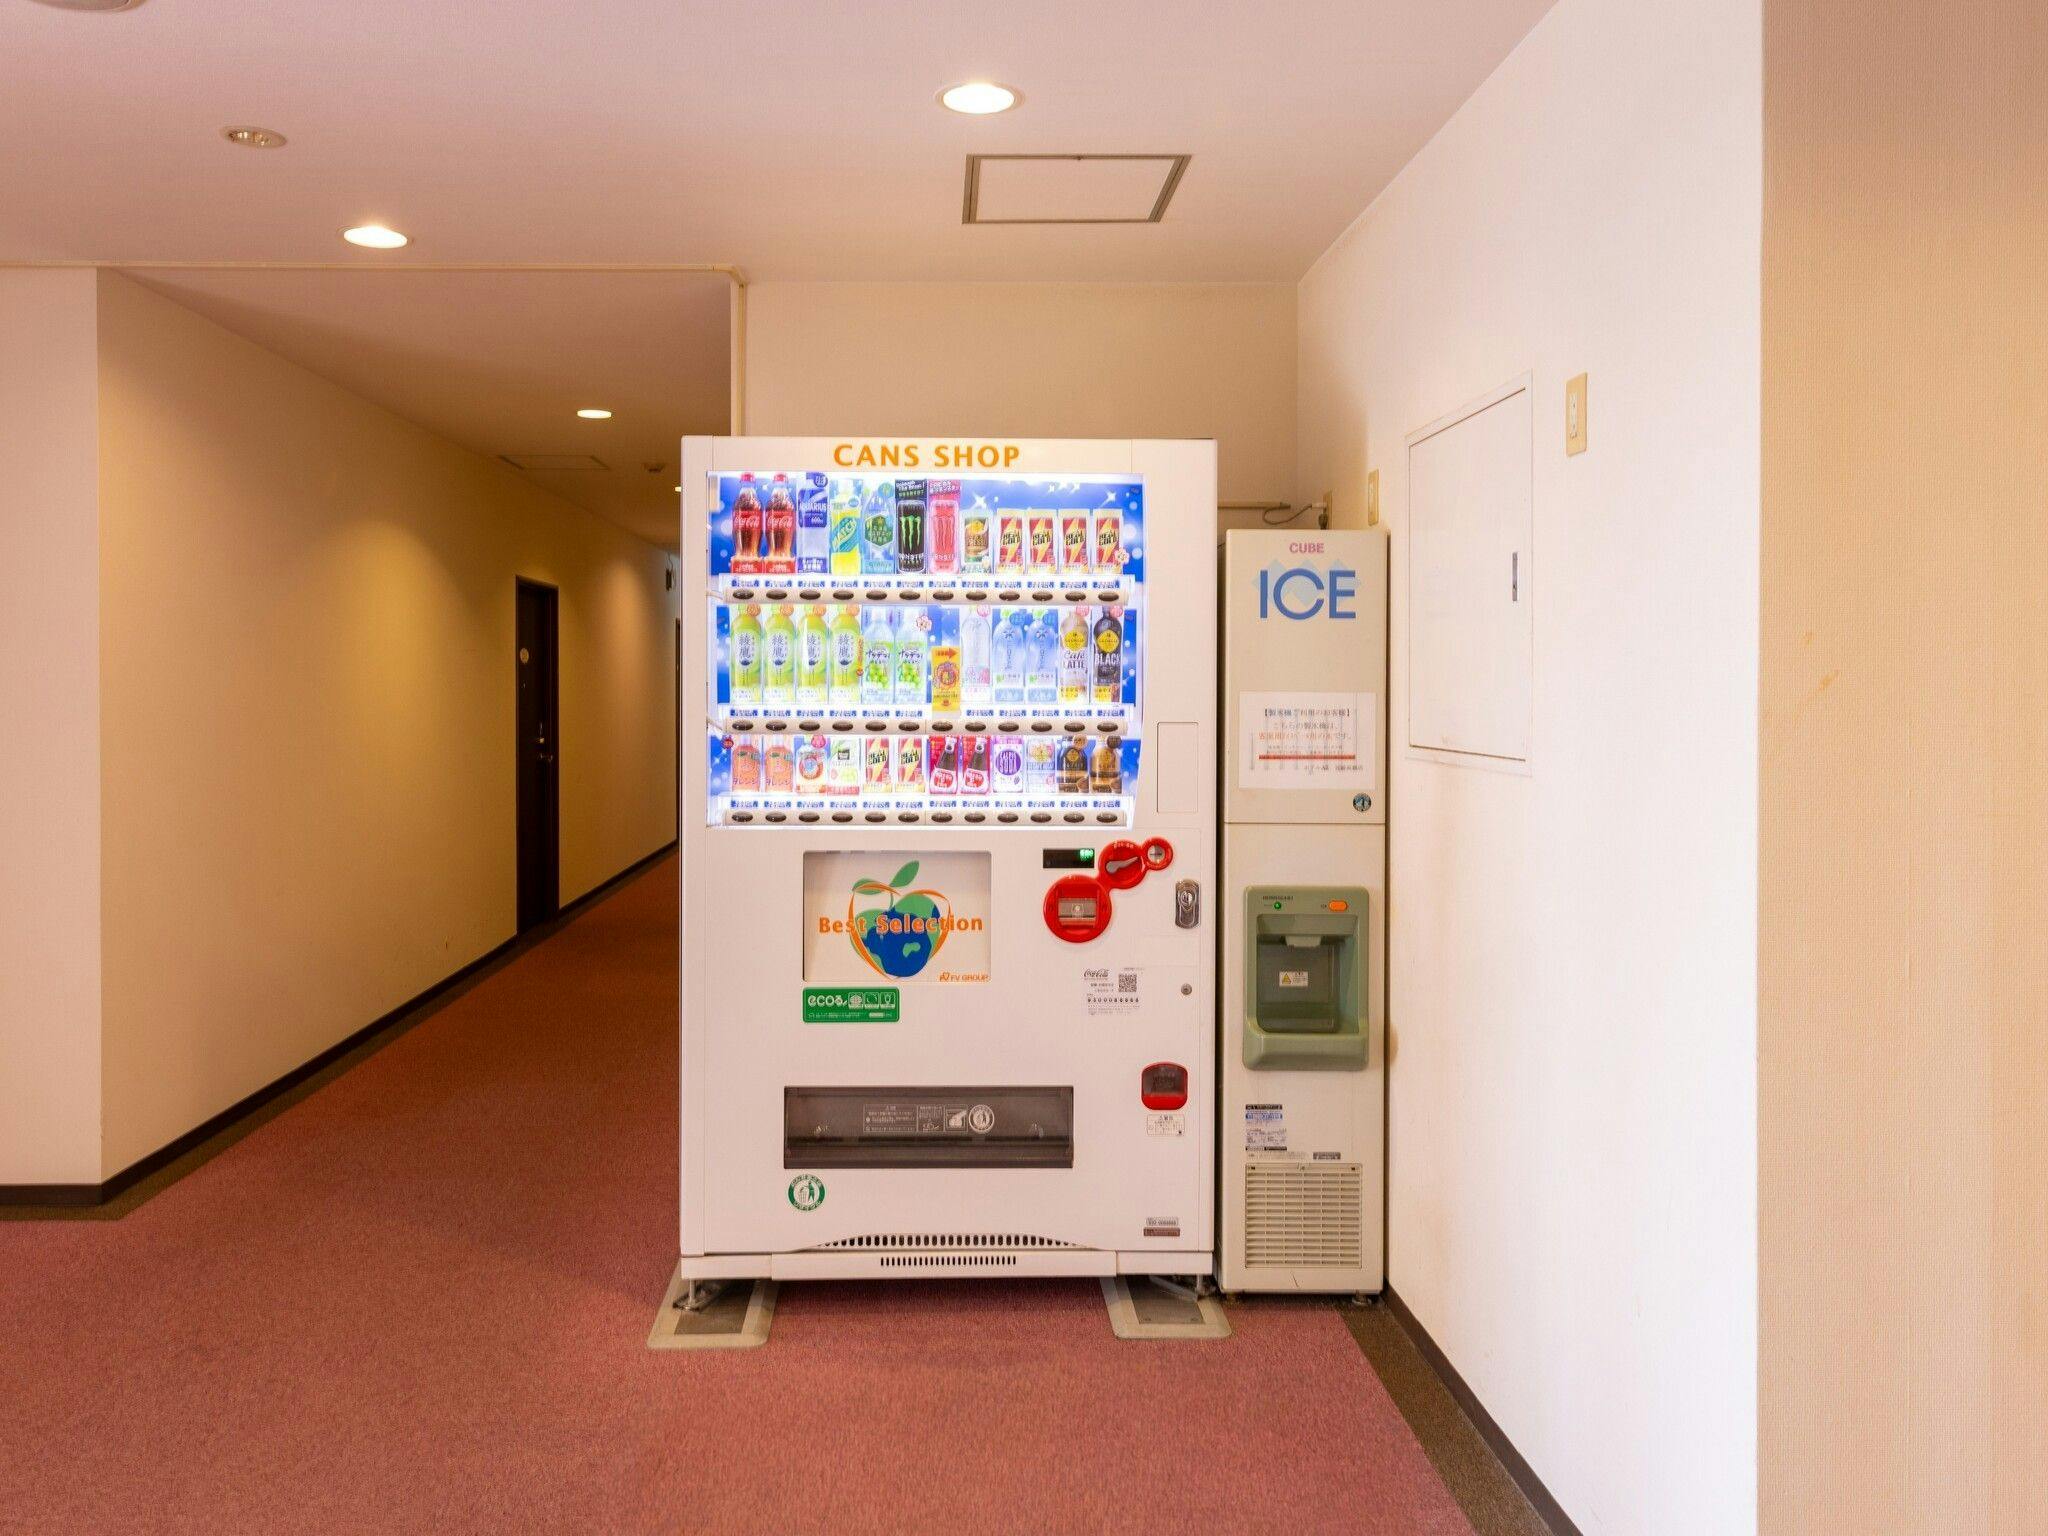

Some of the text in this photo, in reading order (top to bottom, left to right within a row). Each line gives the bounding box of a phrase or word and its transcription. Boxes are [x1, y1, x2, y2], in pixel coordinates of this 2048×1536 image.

[834, 444, 1020, 468] CANS SHOP
[1289, 543, 1325, 554] CUBE
[1259, 568, 1356, 620] ICE
[819, 914, 983, 935] Best Selection
